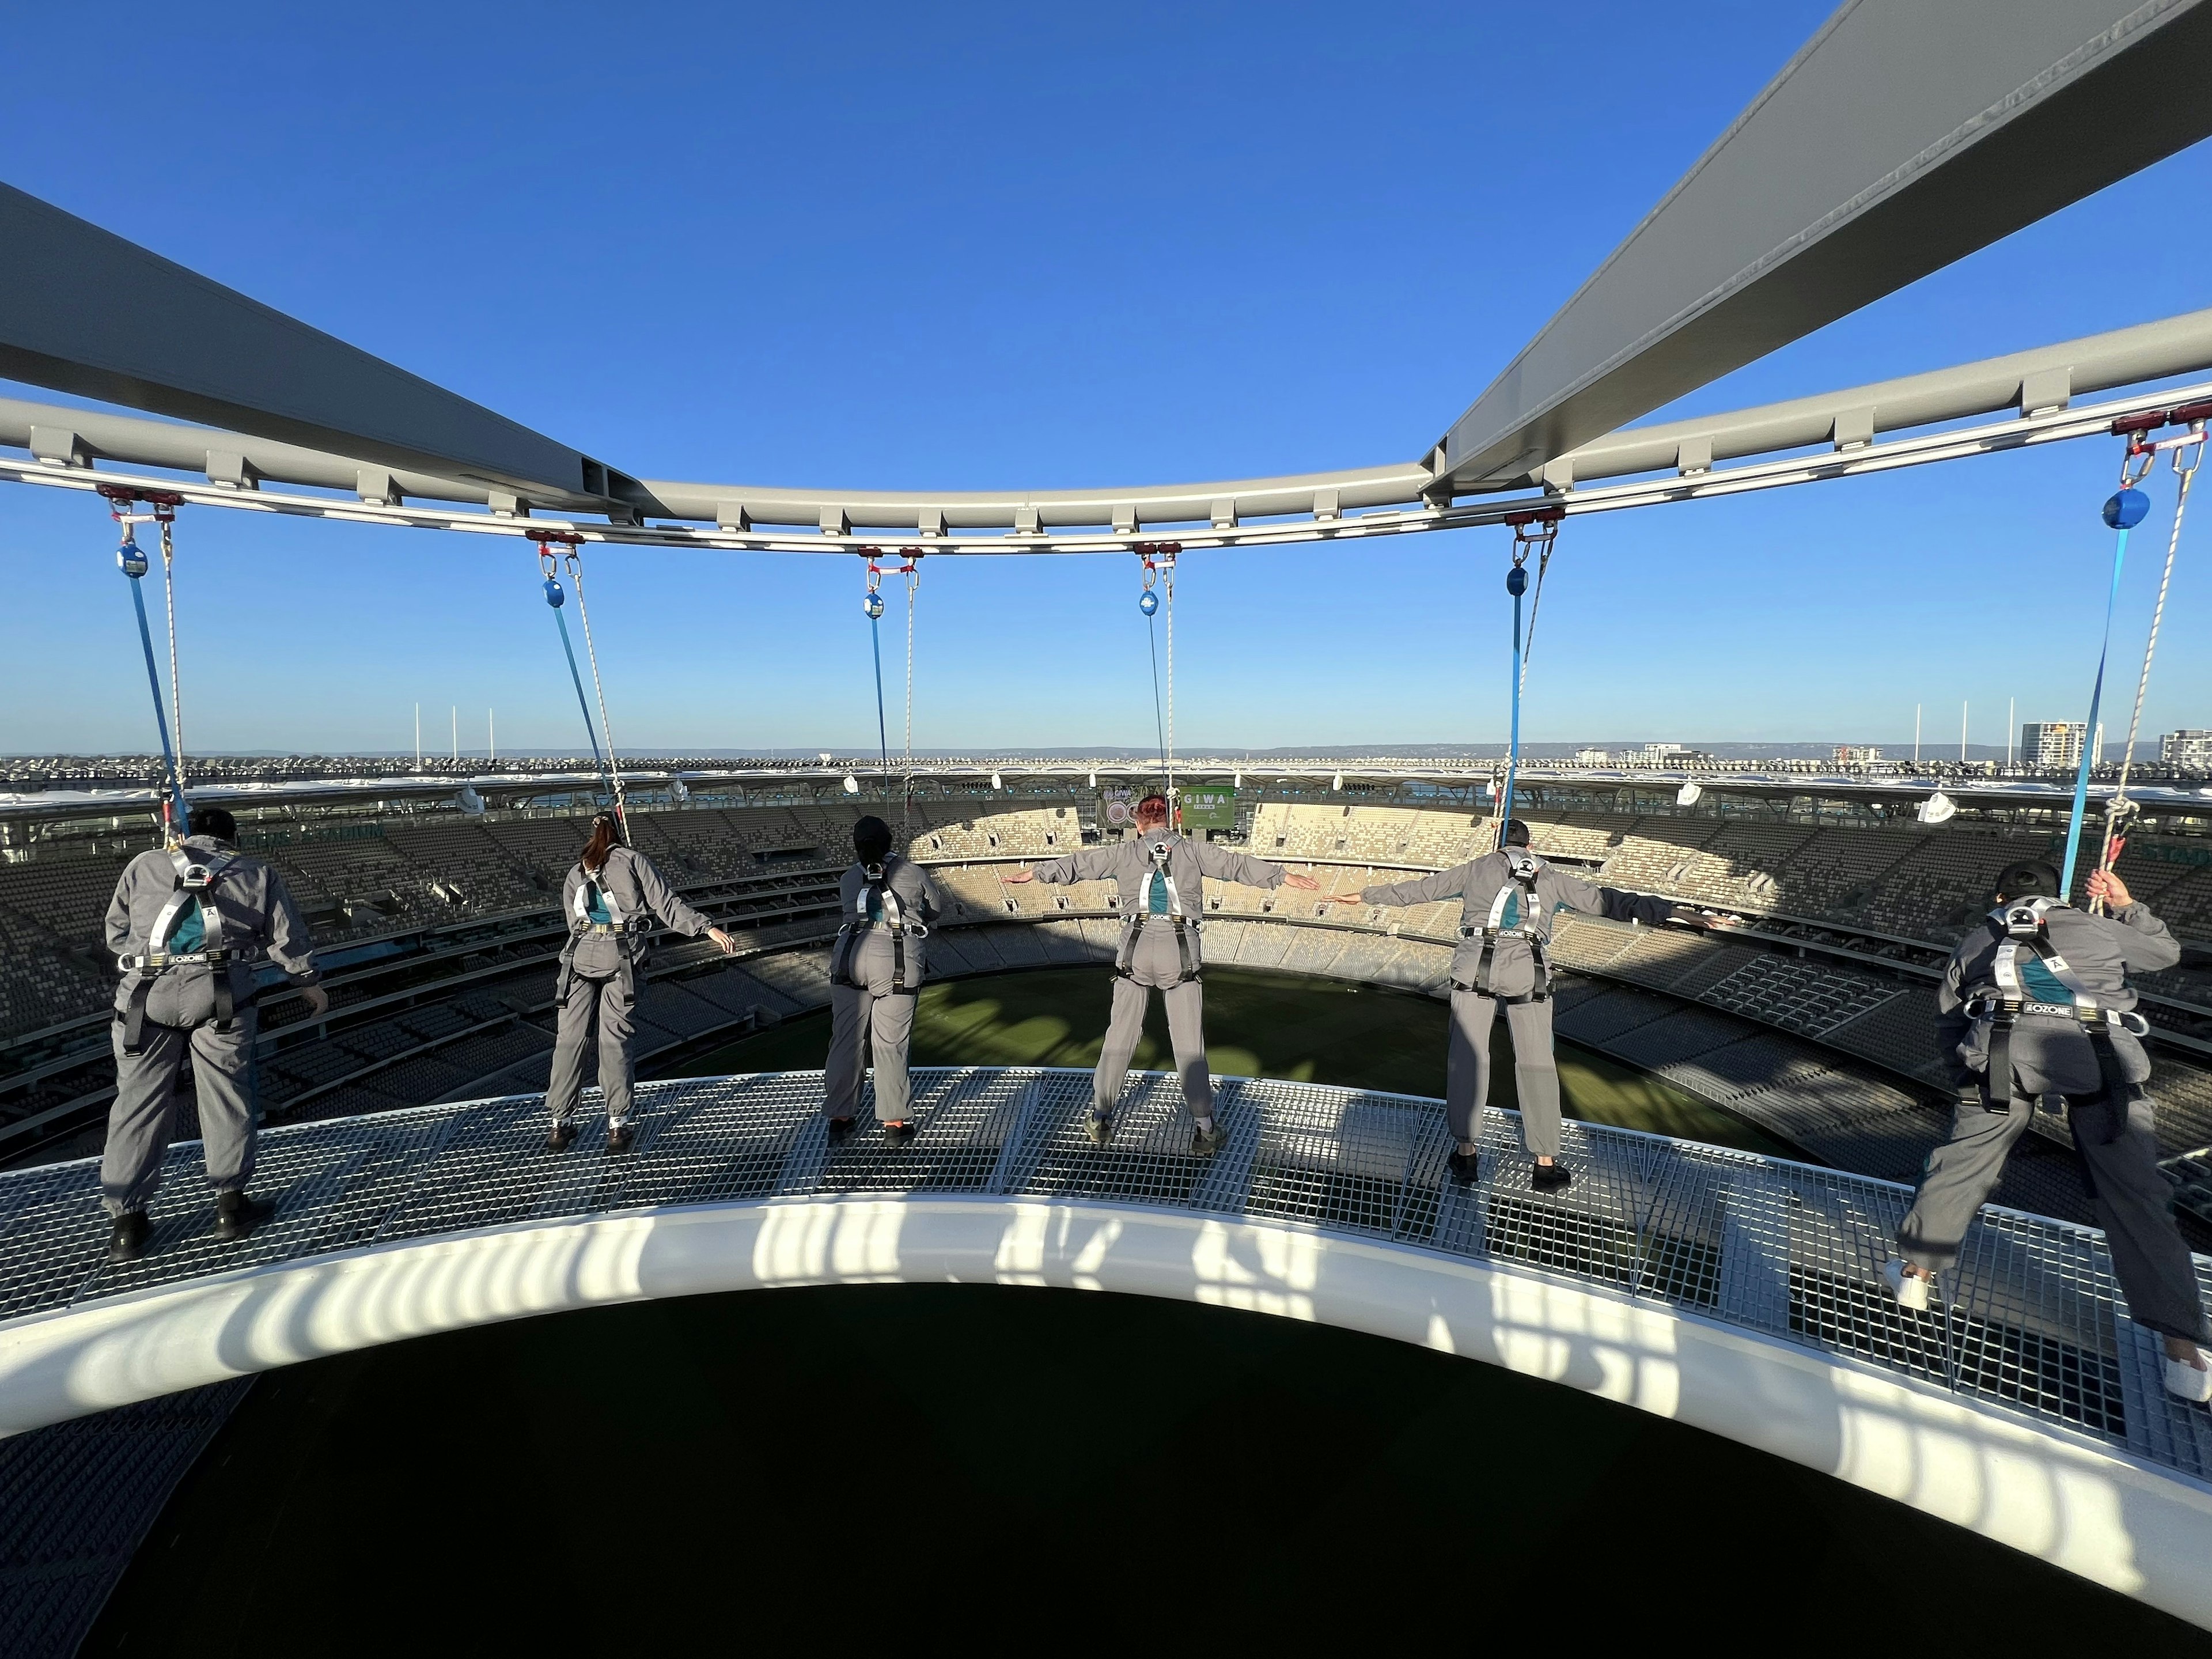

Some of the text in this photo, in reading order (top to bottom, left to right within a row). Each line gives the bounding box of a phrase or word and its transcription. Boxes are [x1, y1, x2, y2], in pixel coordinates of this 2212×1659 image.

[1184, 794, 1225, 804] GIWA
[175, 954, 204, 963] OZONE
[2032, 1004, 2071, 1016] OZONE
